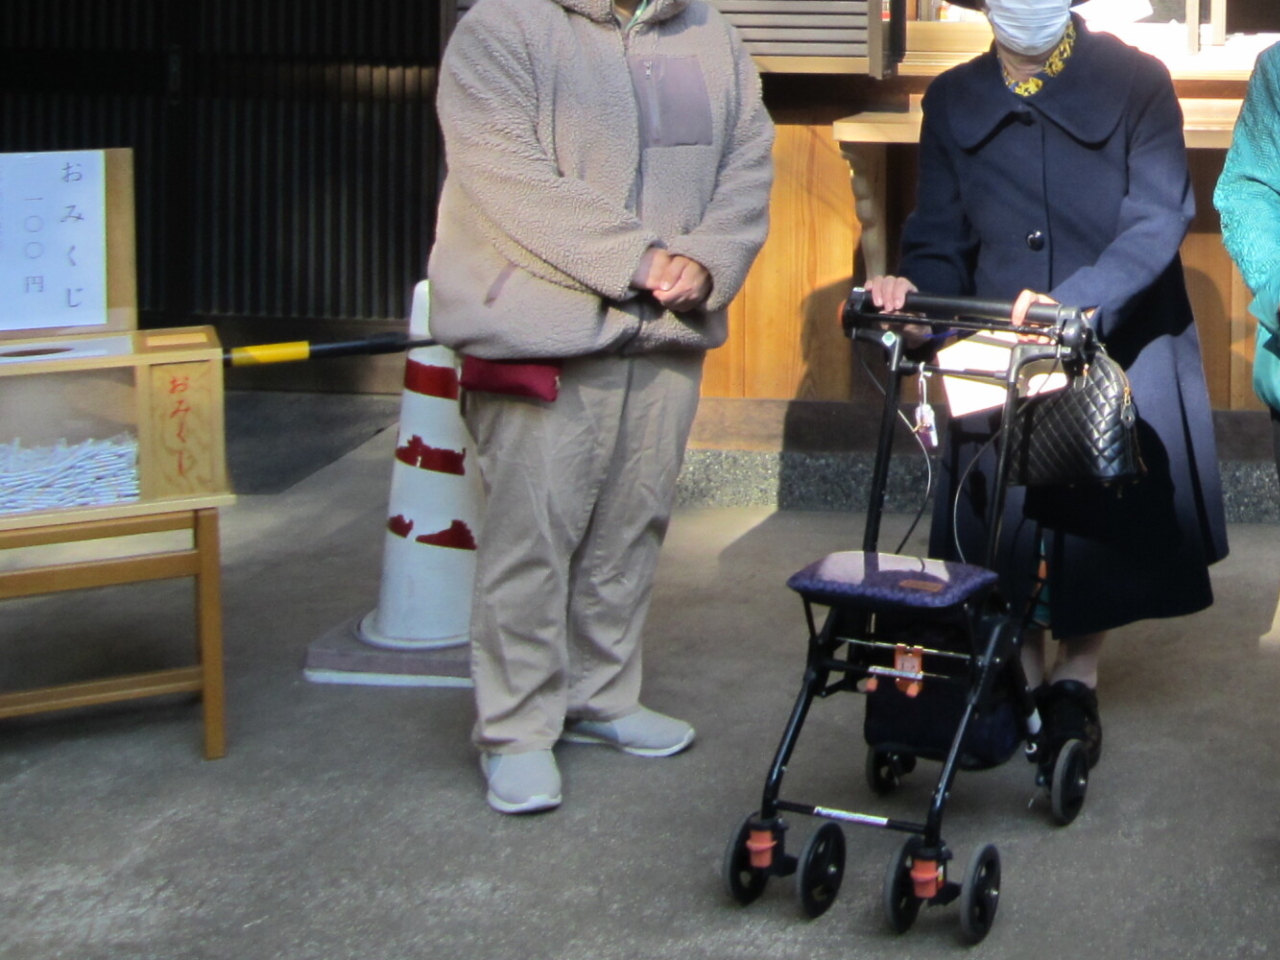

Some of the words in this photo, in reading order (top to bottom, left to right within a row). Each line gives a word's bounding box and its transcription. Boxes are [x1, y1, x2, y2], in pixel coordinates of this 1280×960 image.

[60, 161, 85, 308] おみくじ
[168, 375, 191, 476] おみくじ
